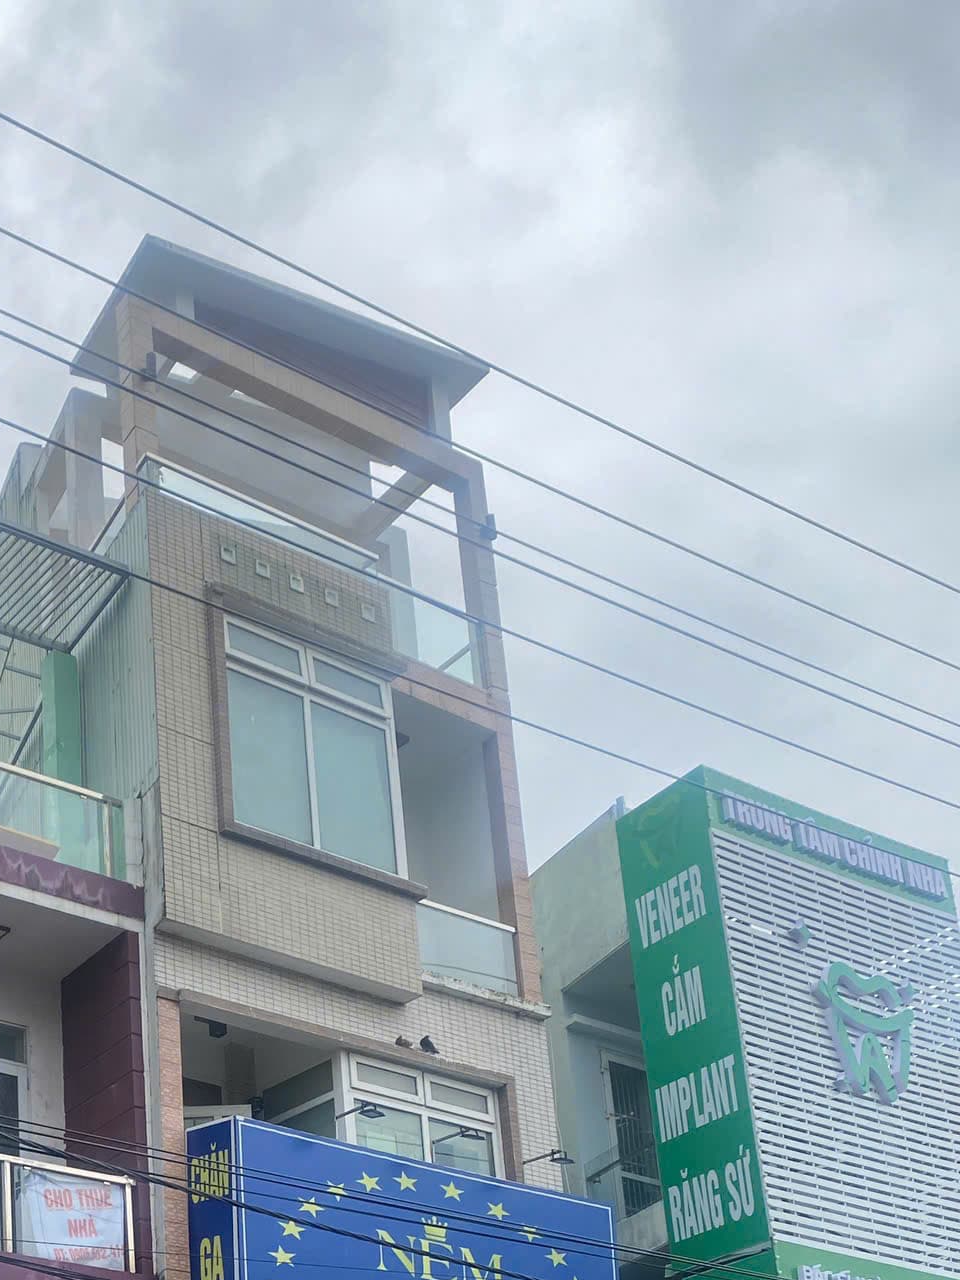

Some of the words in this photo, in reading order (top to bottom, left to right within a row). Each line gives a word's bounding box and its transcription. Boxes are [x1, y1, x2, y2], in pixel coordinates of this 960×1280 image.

[635, 863, 707, 950] VENEER
[655, 1054, 740, 1144] IMPLANT
[43, 1188, 73, 1210] CHO
[667, 1169, 722, 1244] RĂNG
